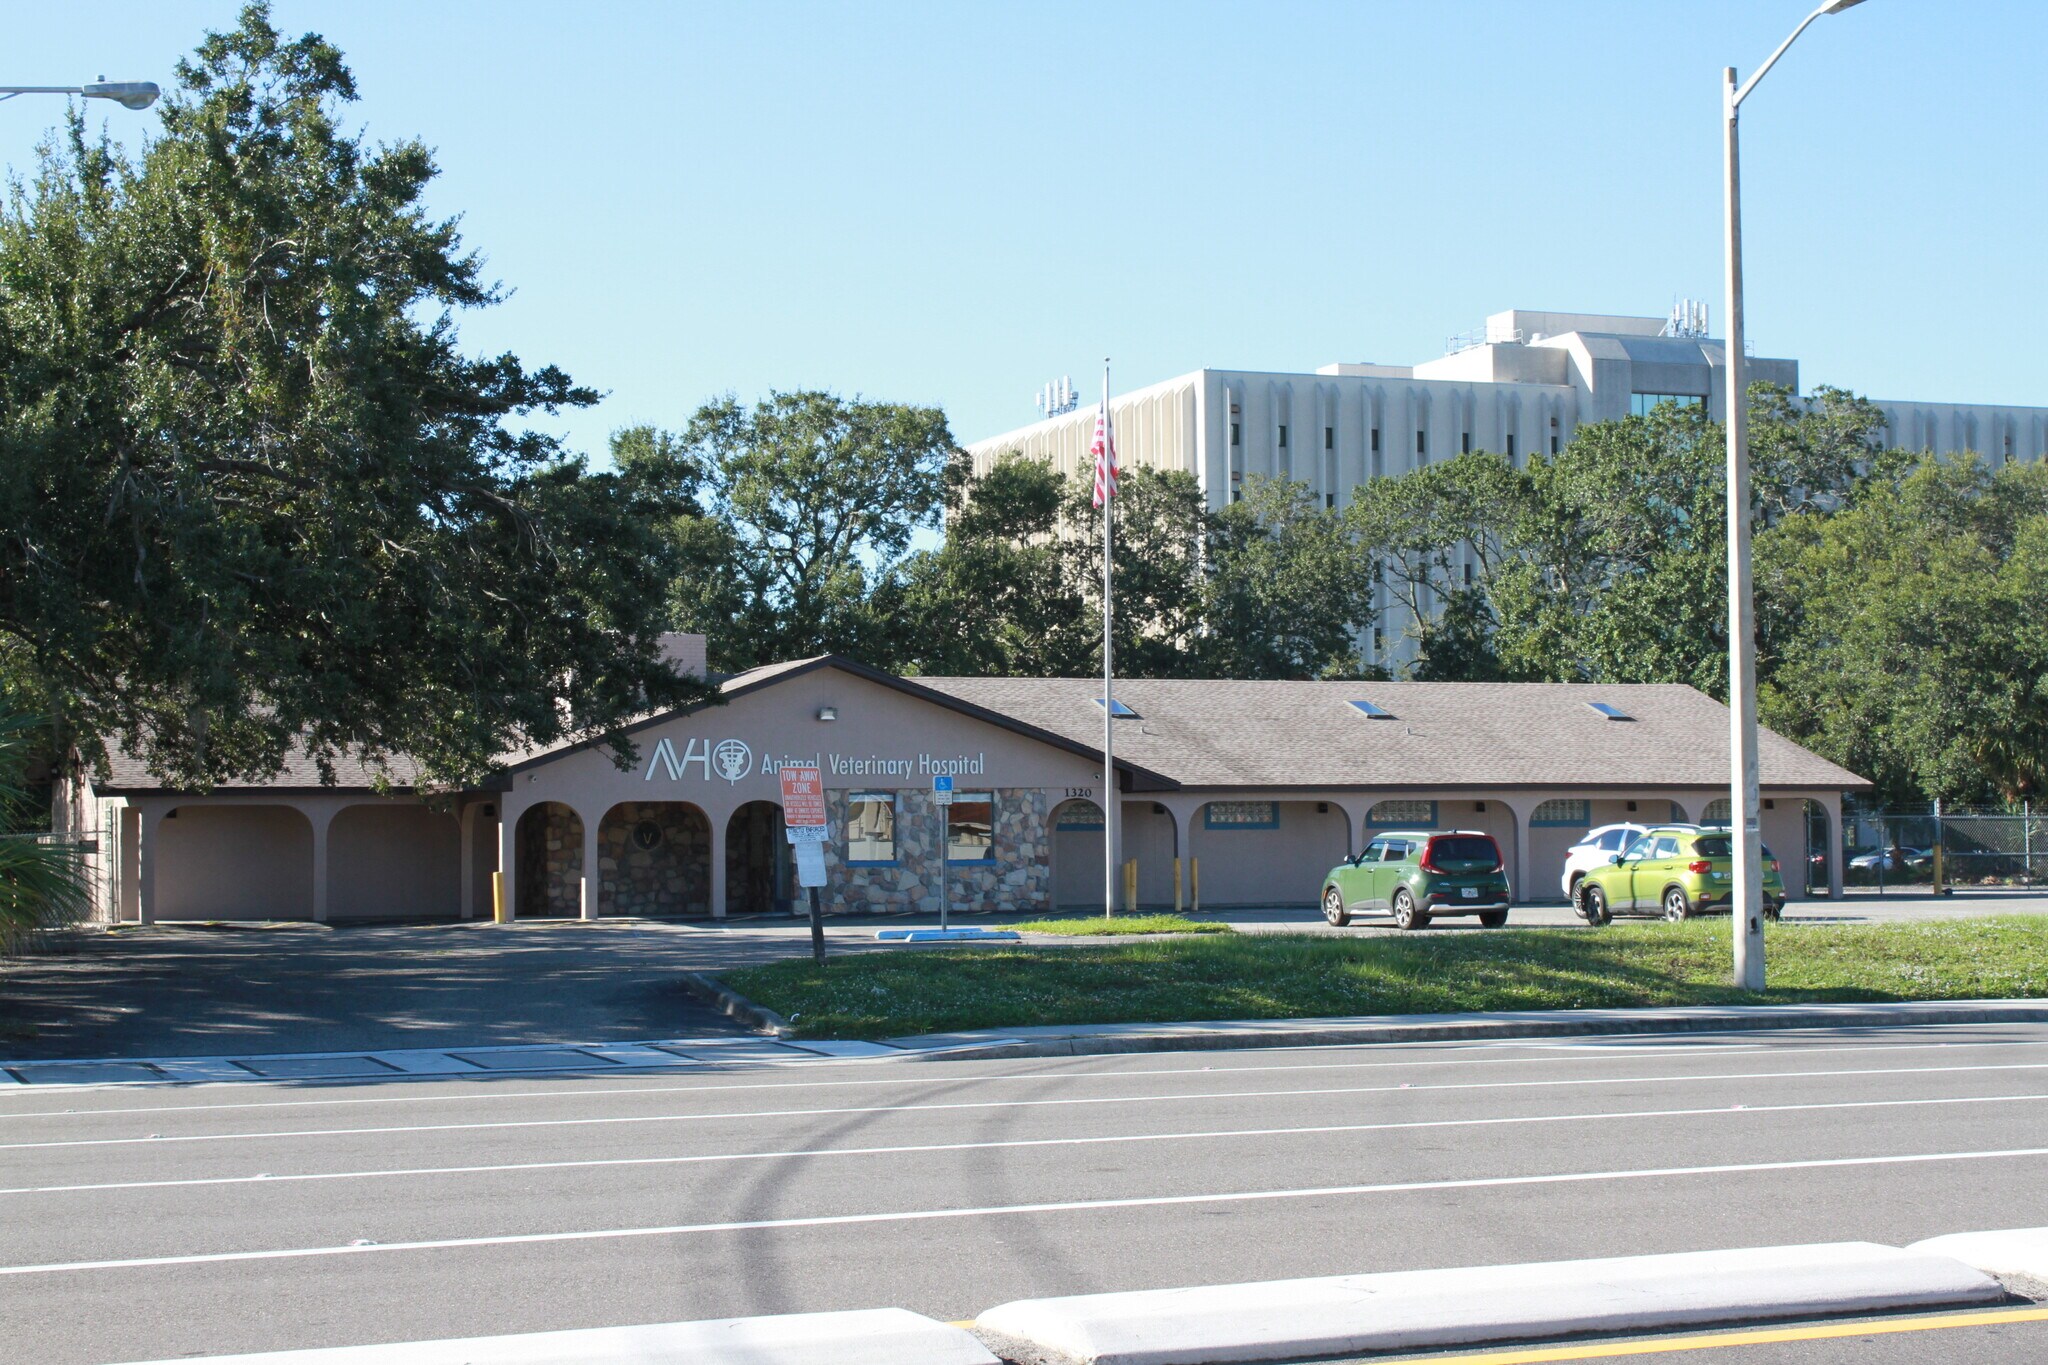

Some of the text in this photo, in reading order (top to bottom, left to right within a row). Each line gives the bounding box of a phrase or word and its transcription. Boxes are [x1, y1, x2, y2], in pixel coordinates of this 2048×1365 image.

[829, 753, 913, 780] Veterinary
[919, 752, 984, 777] Hospital
[781, 770, 818, 782] TOW AWAY
[792, 782, 812, 794] ZONE
[1065, 788, 1092, 798] 1320
